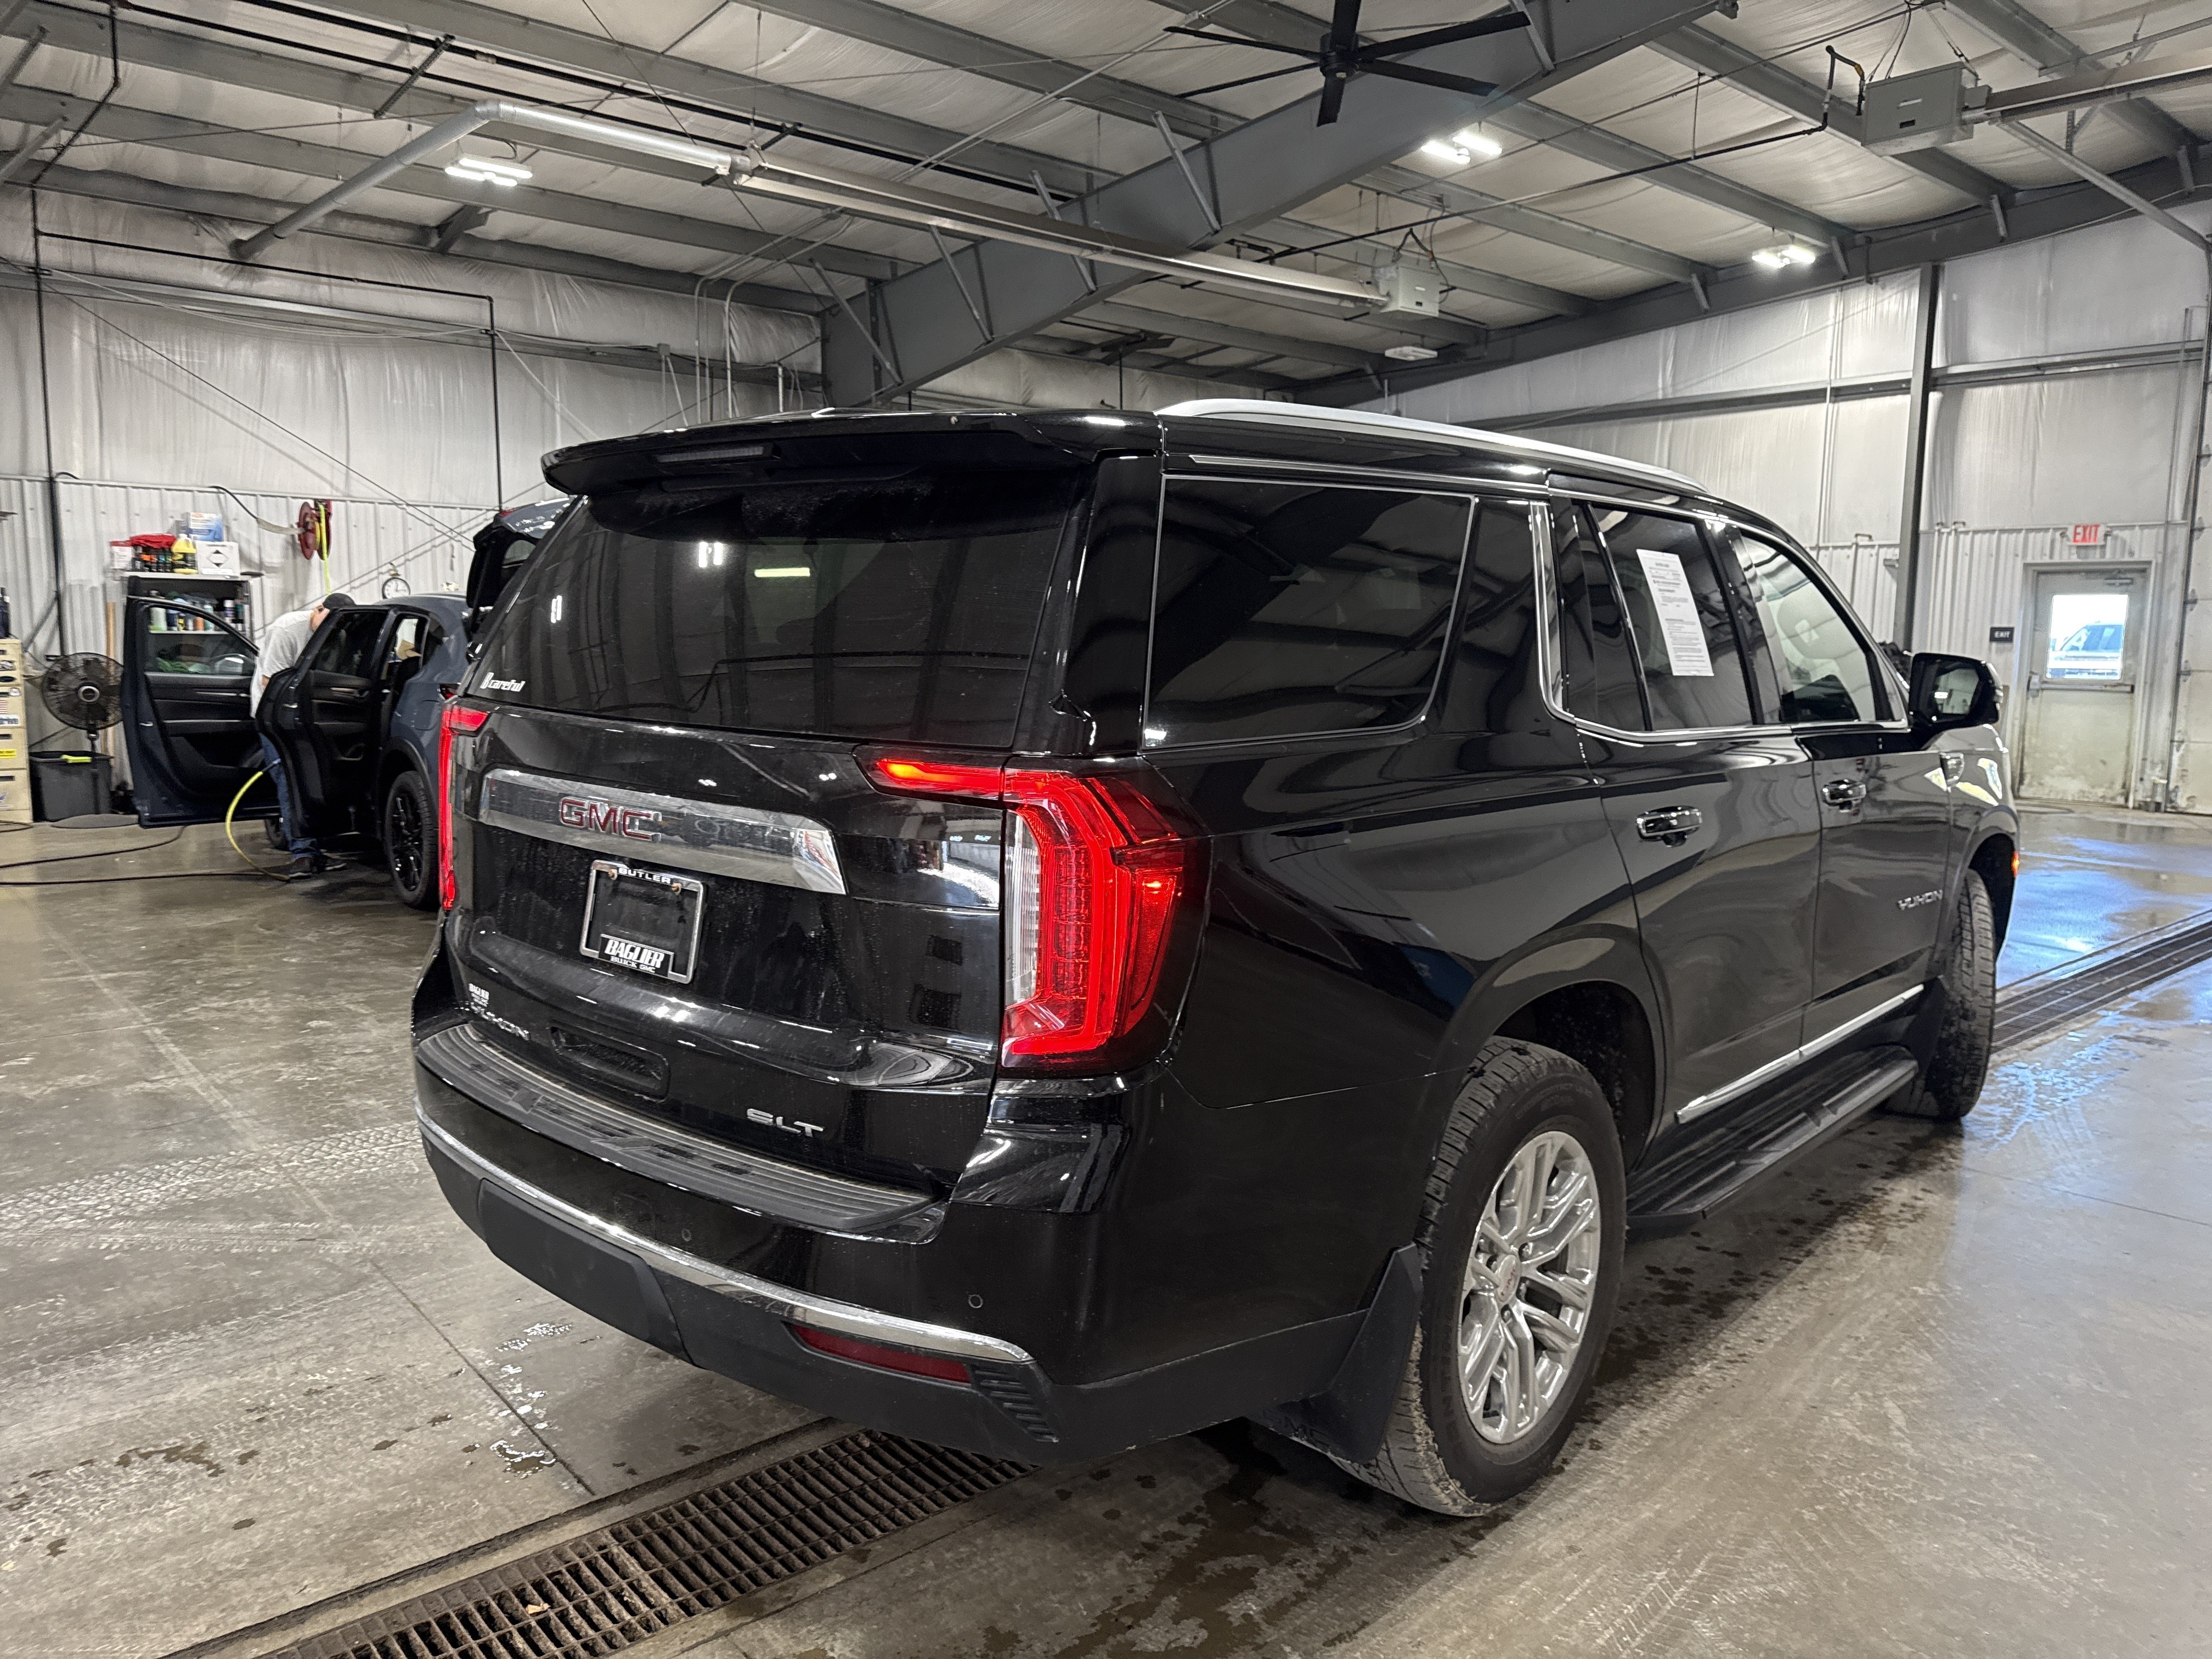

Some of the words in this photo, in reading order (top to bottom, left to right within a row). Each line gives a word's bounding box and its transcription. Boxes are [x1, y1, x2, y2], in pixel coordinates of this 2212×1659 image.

[2073, 524, 2101, 543] EXIT
[559, 796, 662, 843] GMC
[618, 867, 671, 884] BUTLER
[604, 939, 665, 968] BAGLIER
[610, 956, 637, 968] BUICK
[639, 964, 656, 973] GMC
[747, 1108, 823, 1137] SLT
